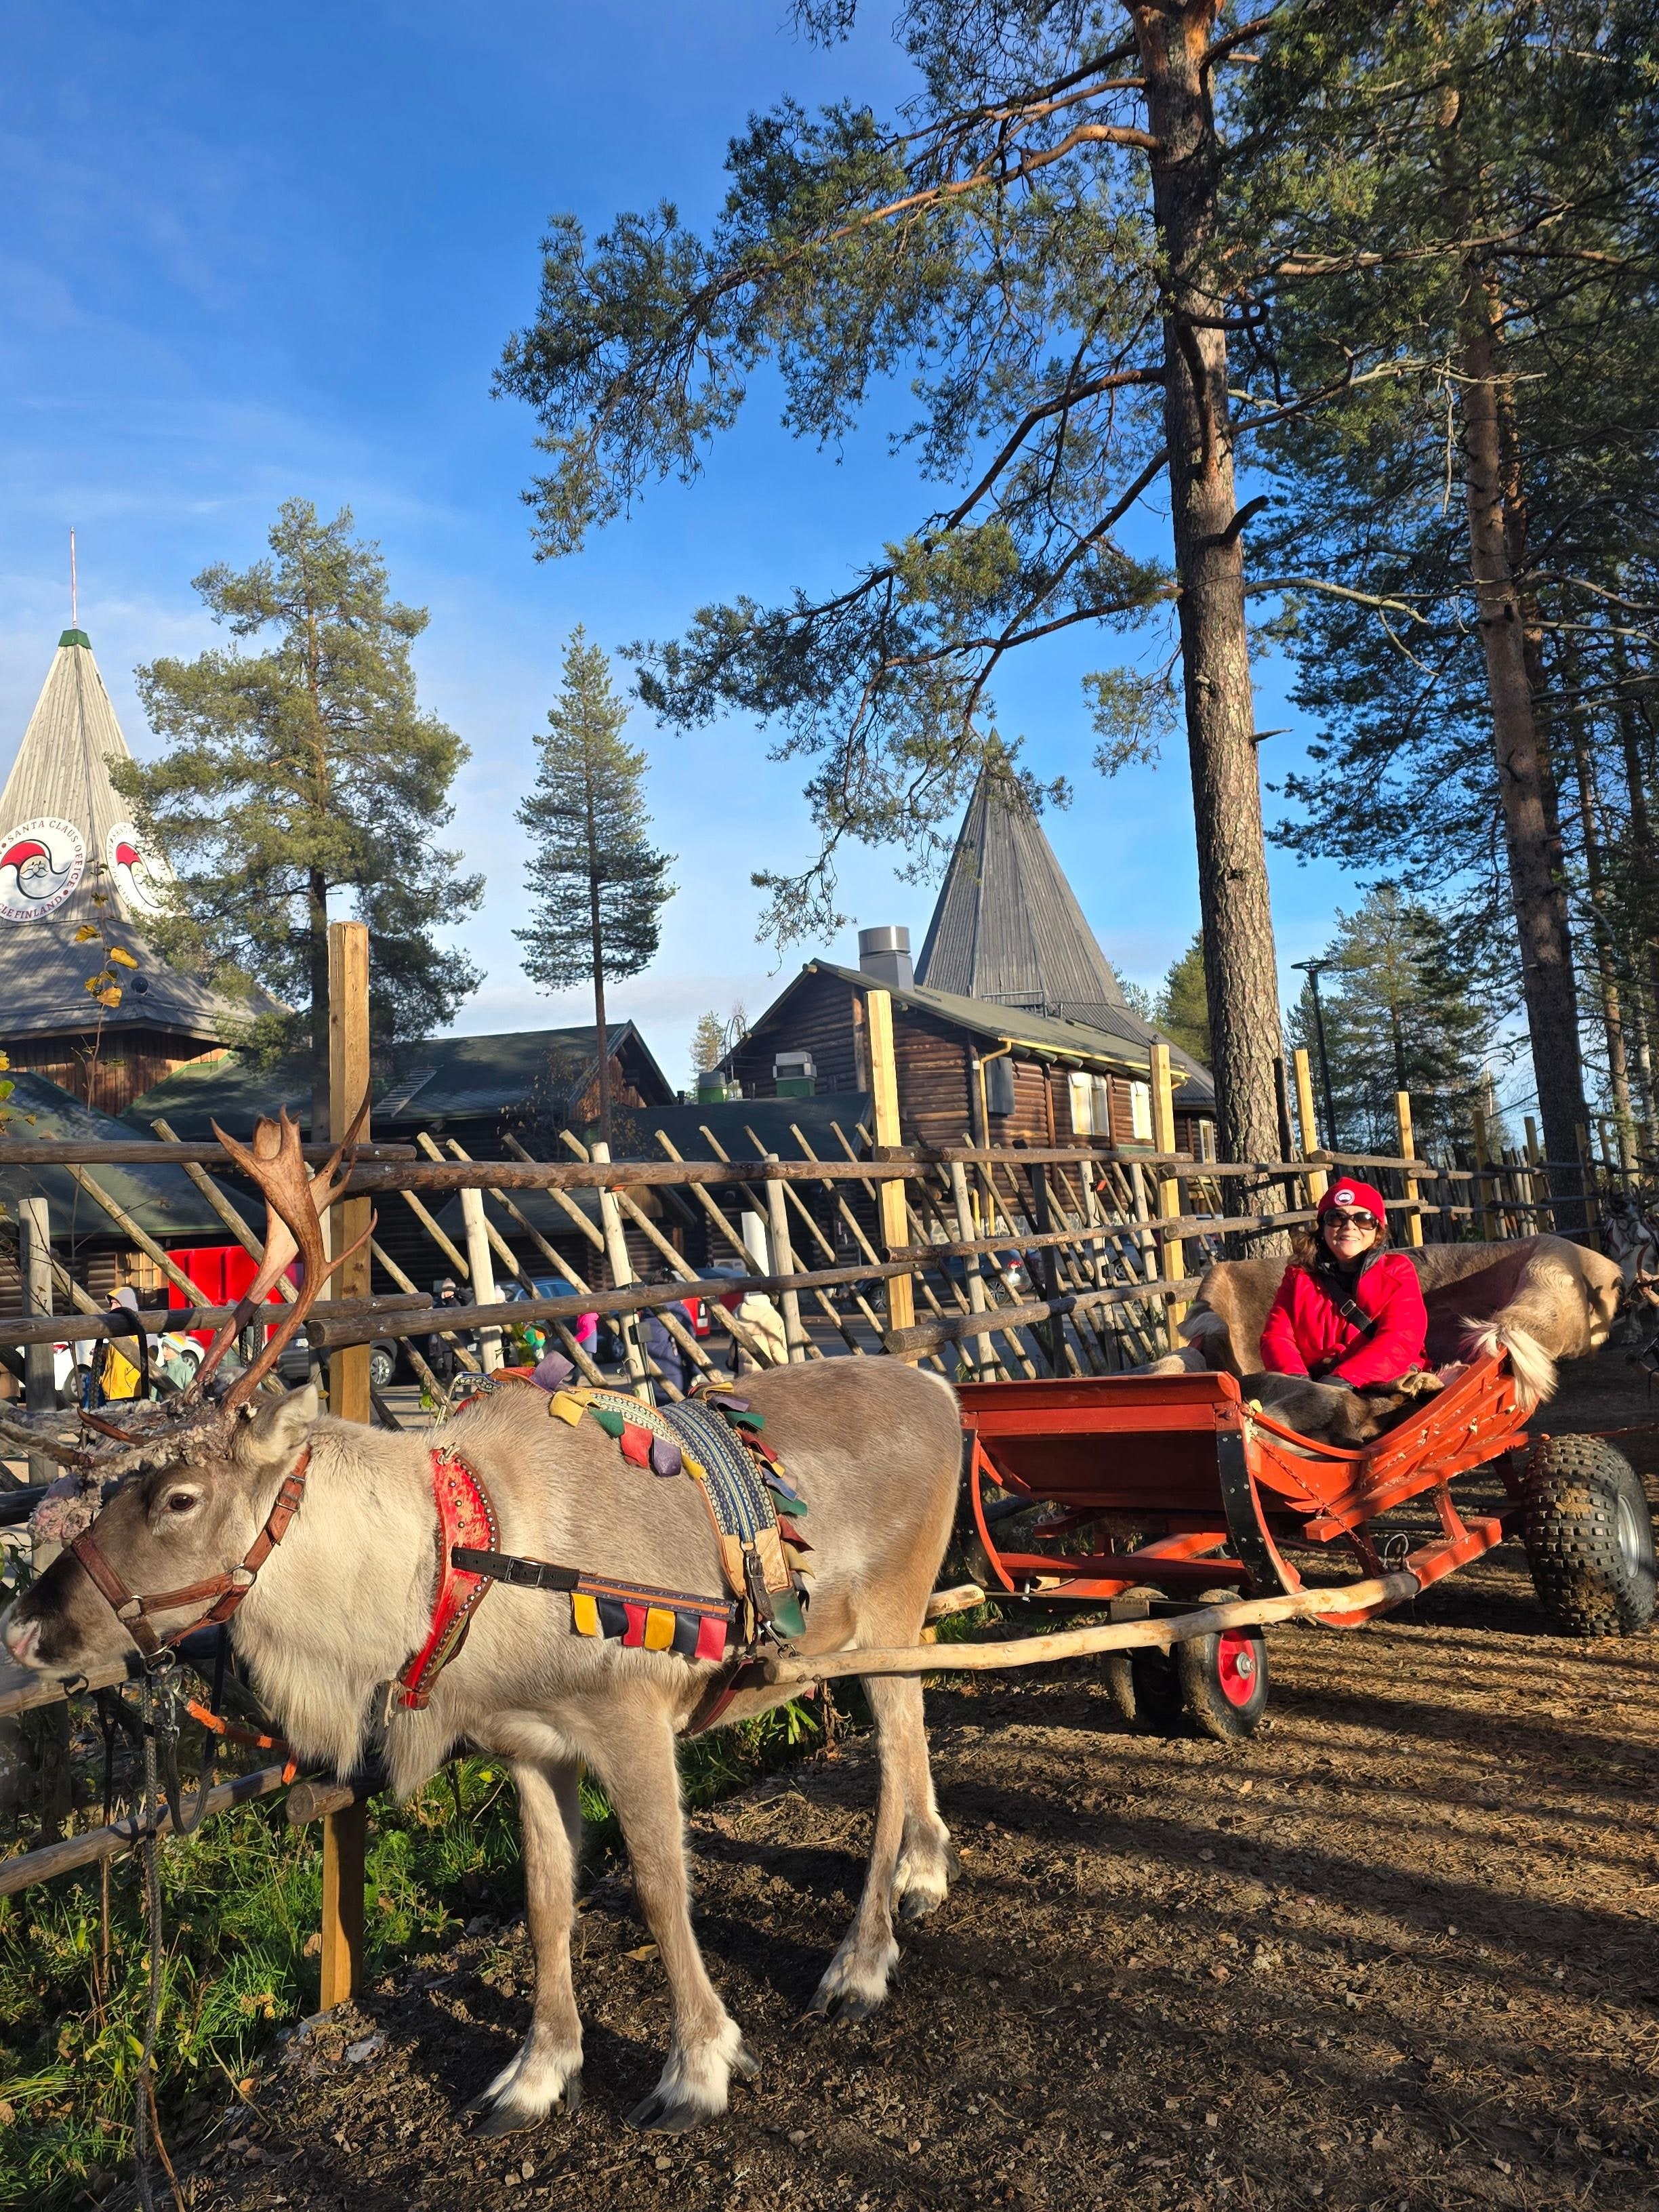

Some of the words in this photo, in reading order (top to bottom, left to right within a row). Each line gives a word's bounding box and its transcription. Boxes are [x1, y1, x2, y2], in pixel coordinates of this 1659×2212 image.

[7, 820, 45, 842] SANTA
[49, 820, 79, 842] CLAUS
[67, 844, 83, 888] OFFICE
[14, 896, 62, 919] FINLAND
